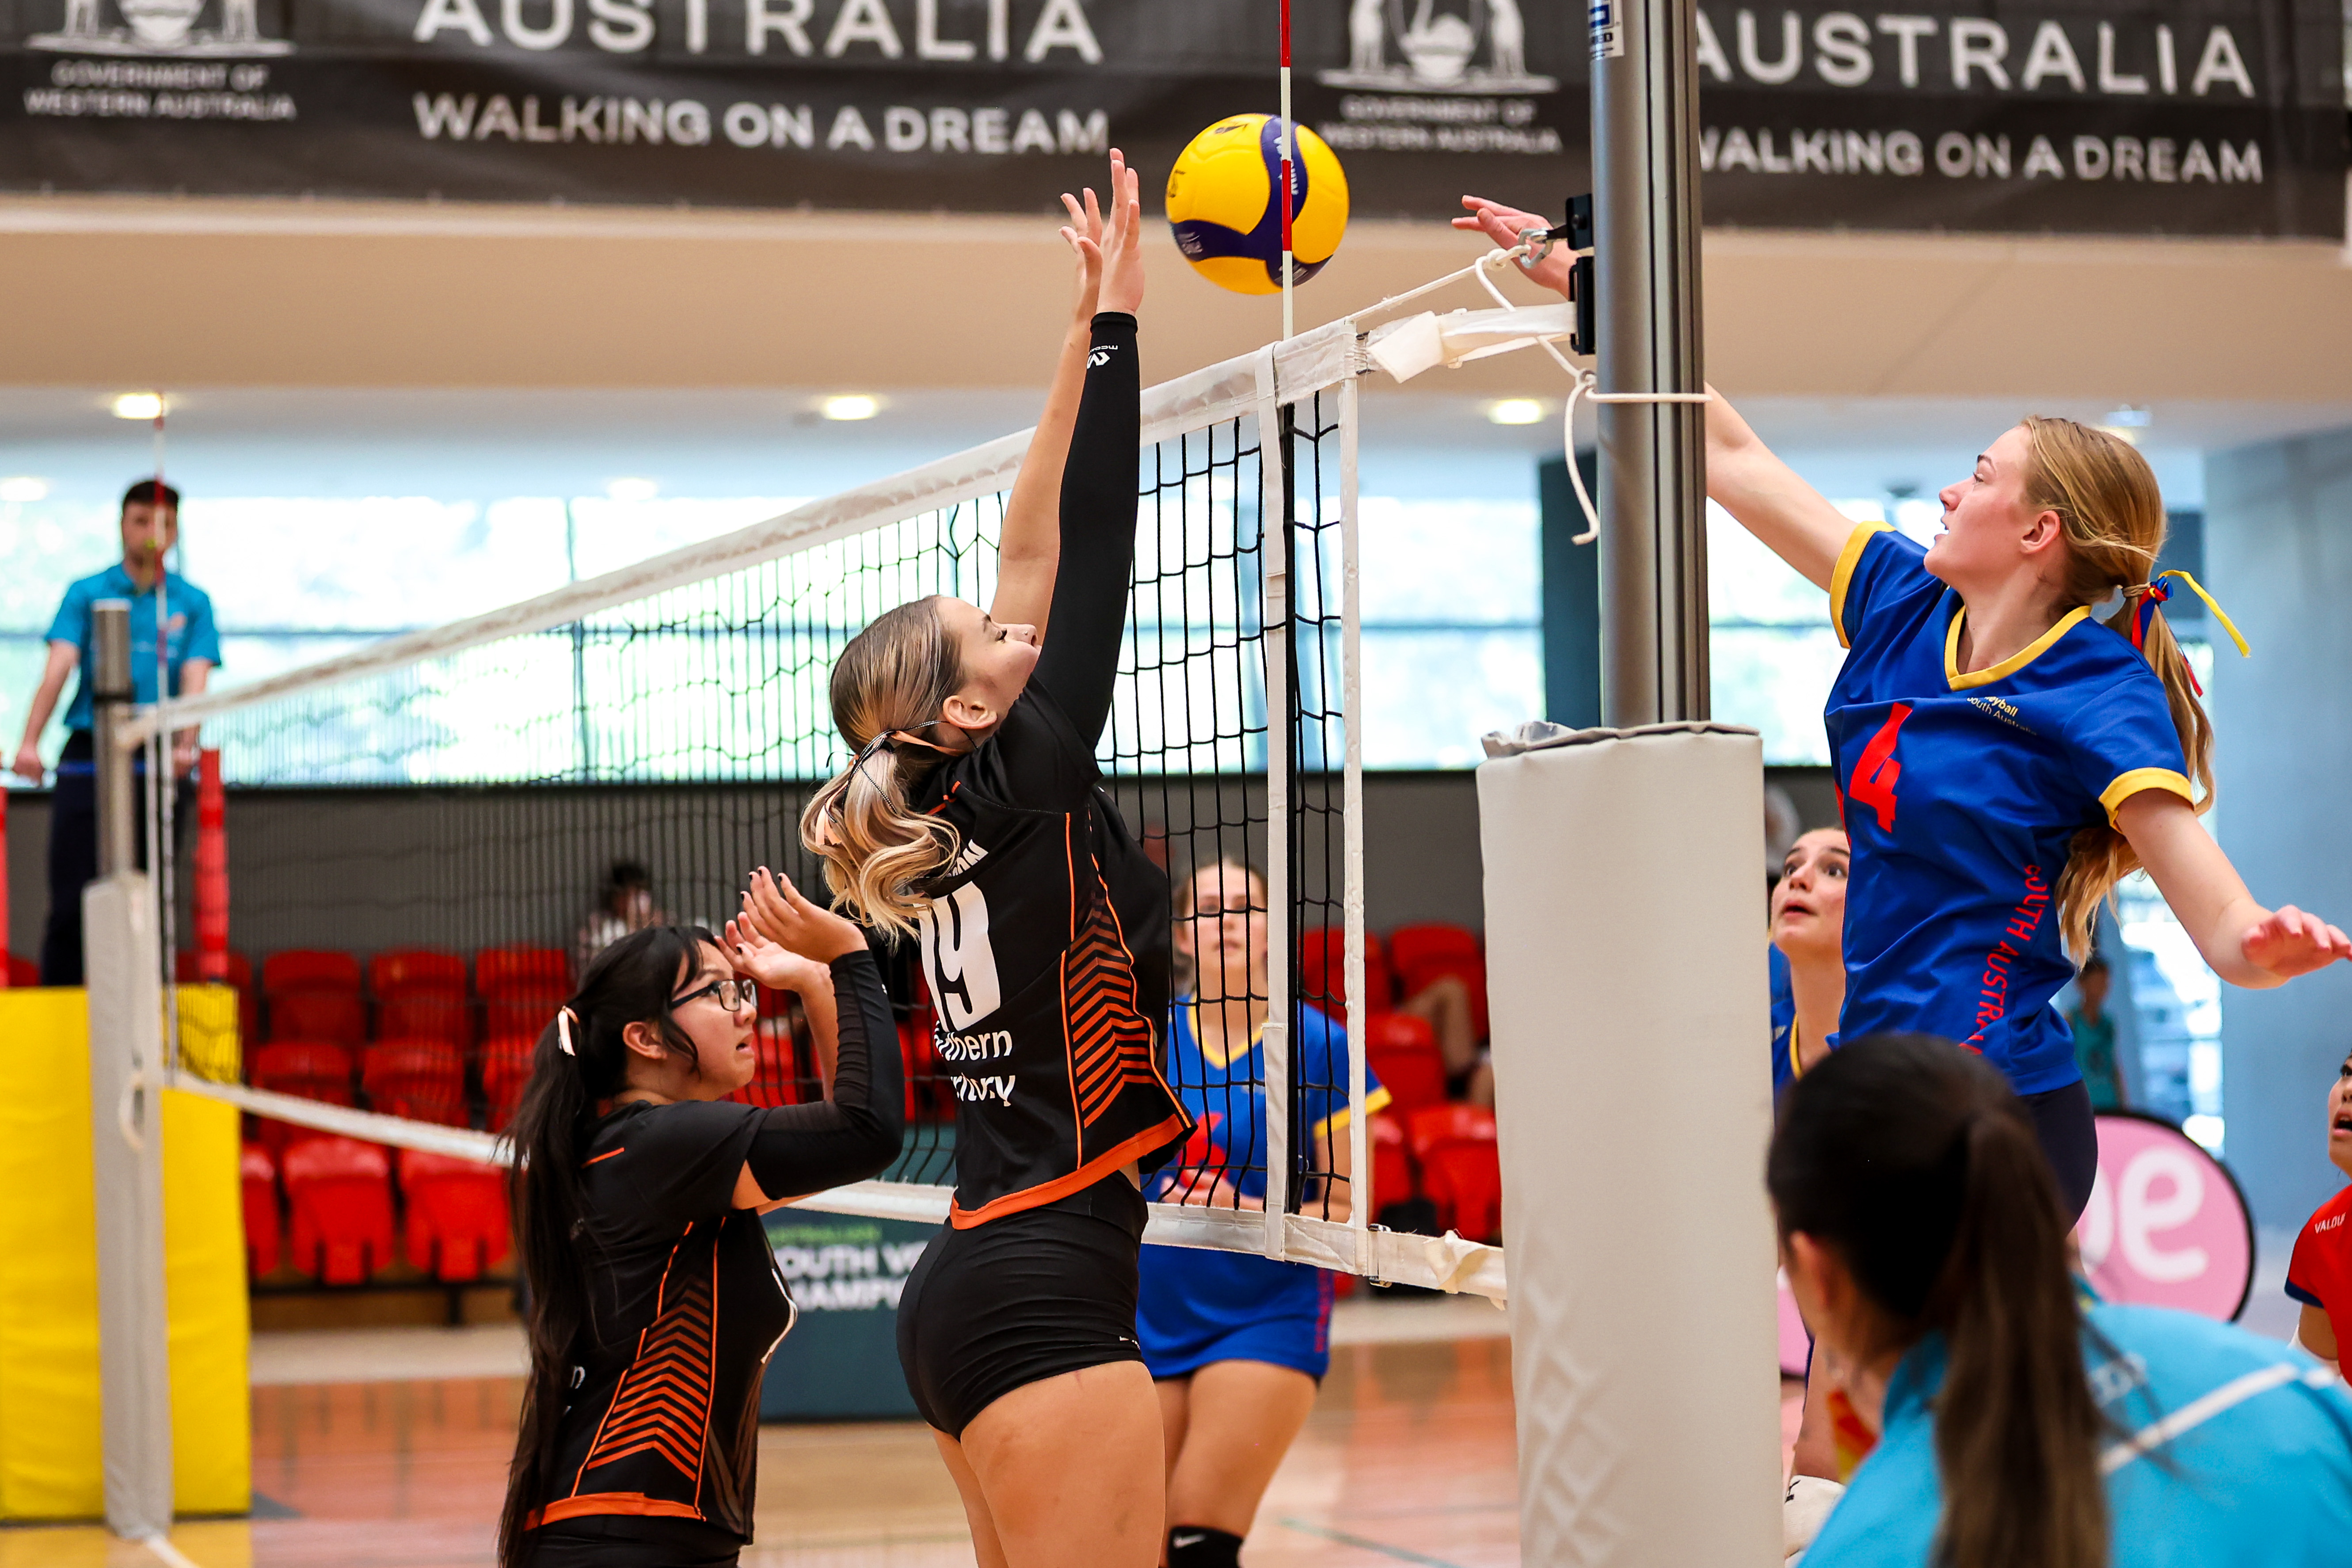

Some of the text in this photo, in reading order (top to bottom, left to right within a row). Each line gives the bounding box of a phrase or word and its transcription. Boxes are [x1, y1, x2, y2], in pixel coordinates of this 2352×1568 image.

[412, 92, 1109, 156] WALKING ON A DREAM
[1935, 131, 2012, 178] ON
[2023, 135, 2065, 179] A
[2073, 135, 2263, 184] DREAM
[1849, 702, 1913, 834] 4
[913, 880, 1001, 1033] 19
